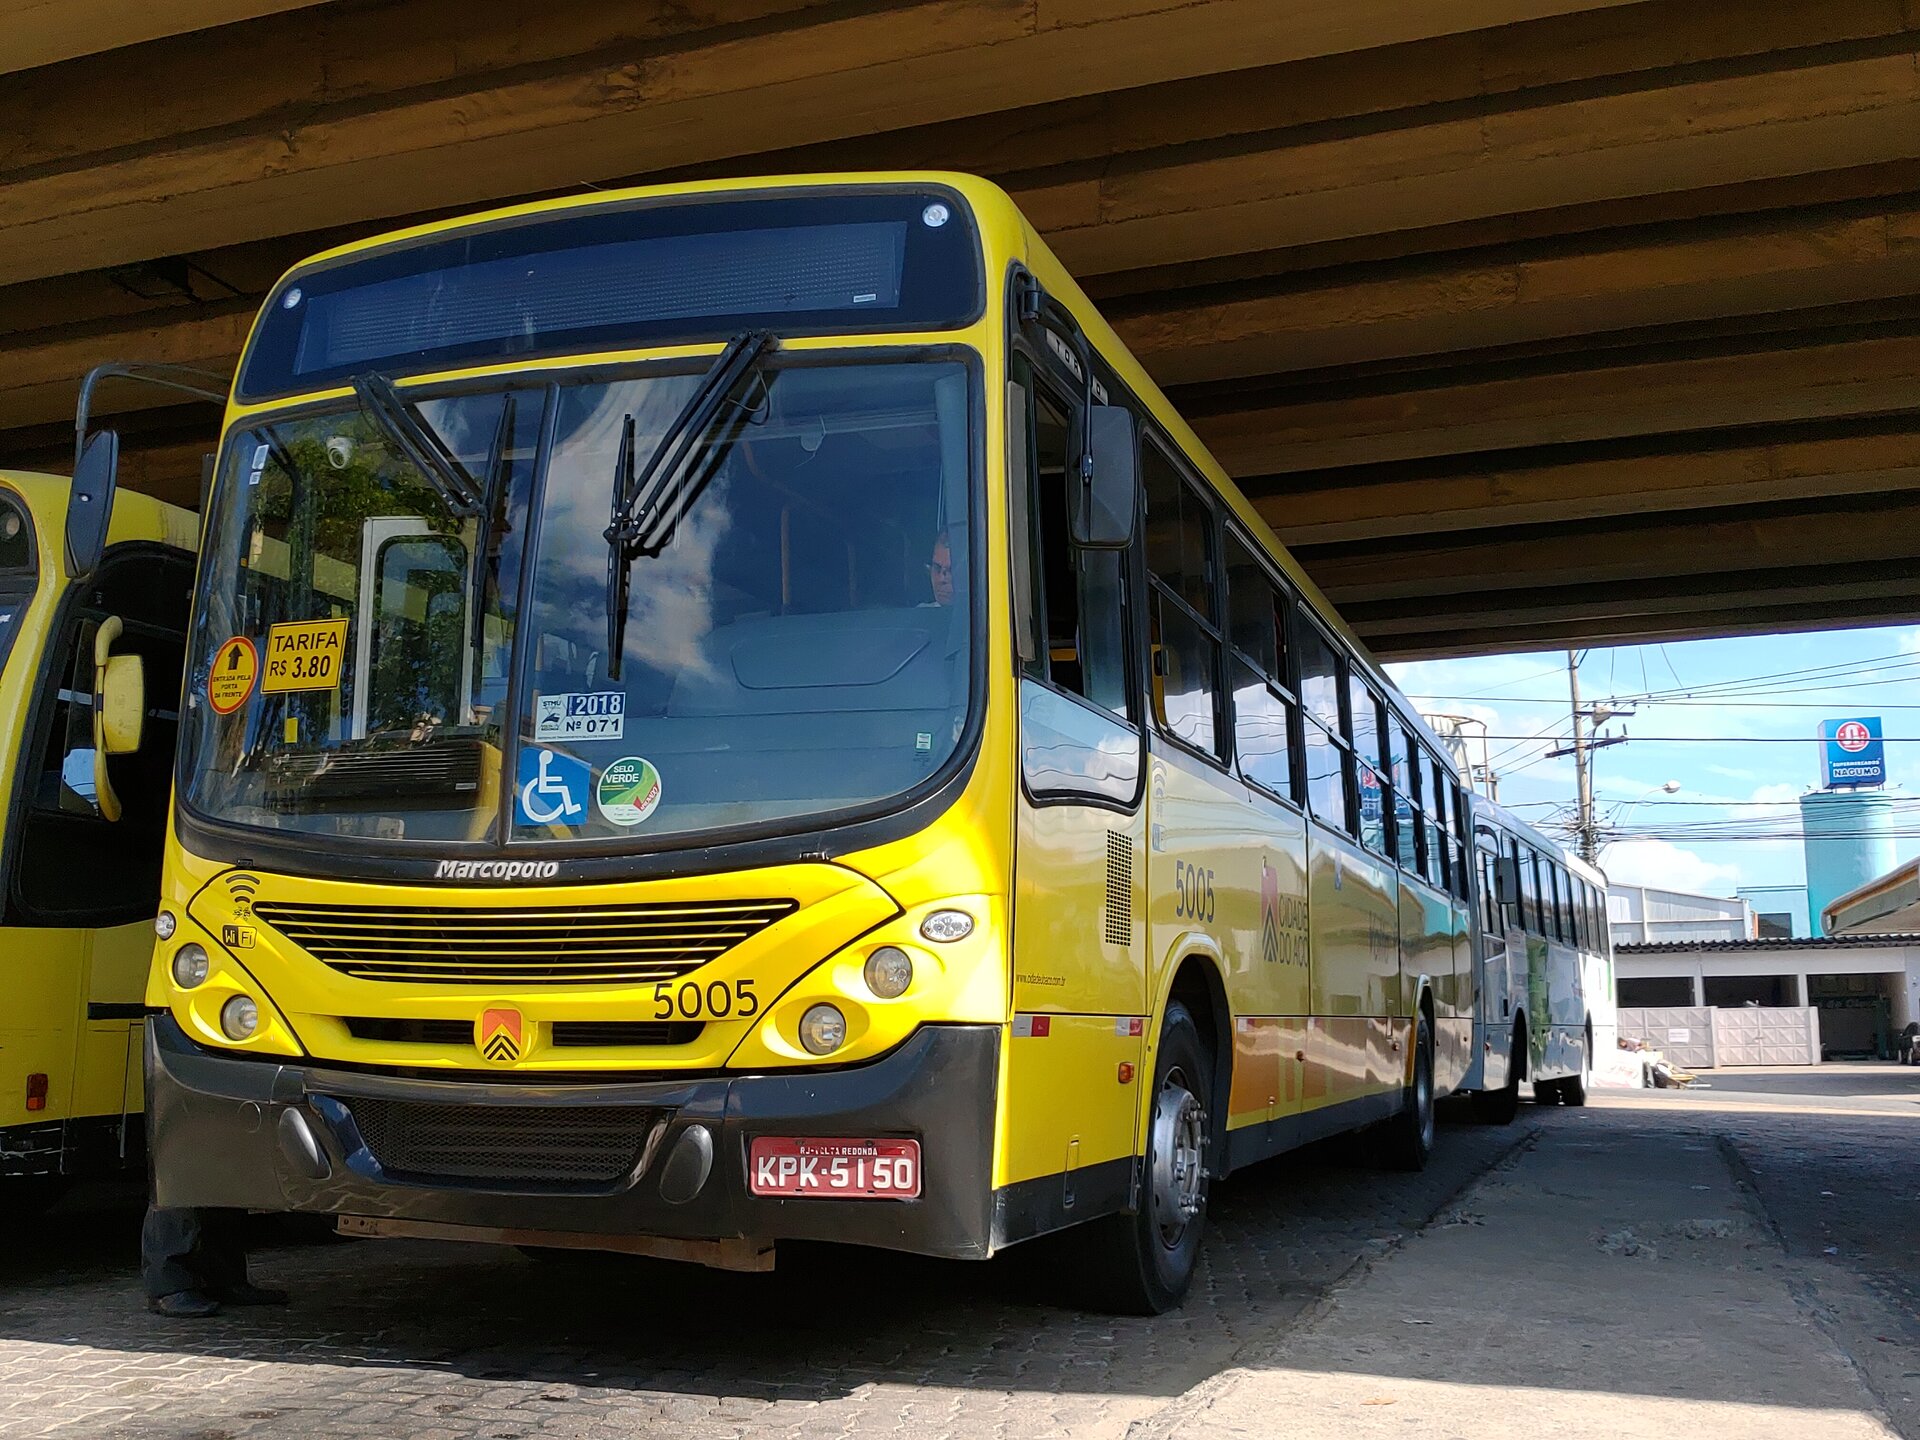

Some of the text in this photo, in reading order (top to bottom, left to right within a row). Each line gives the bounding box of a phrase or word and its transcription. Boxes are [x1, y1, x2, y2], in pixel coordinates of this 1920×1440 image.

[1056, 338, 1100, 395] TORO
[274, 631, 338, 652] TARIFA
[269, 655, 330, 678] R$ 3.80
[575, 695, 621, 715] 2018
[587, 718, 619, 732] 071
[605, 773, 639, 783] VERDE
[613, 765, 634, 773] SELO
[1833, 767, 1880, 777] NAGUMO
[434, 860, 559, 880] Marcopolo
[1176, 860, 1214, 923] 5005
[1279, 893, 1308, 933] CIDADE
[1280, 931, 1291, 965] DO
[654, 979, 758, 1019] 5005
[842, 1147, 878, 1156] REDONDA
